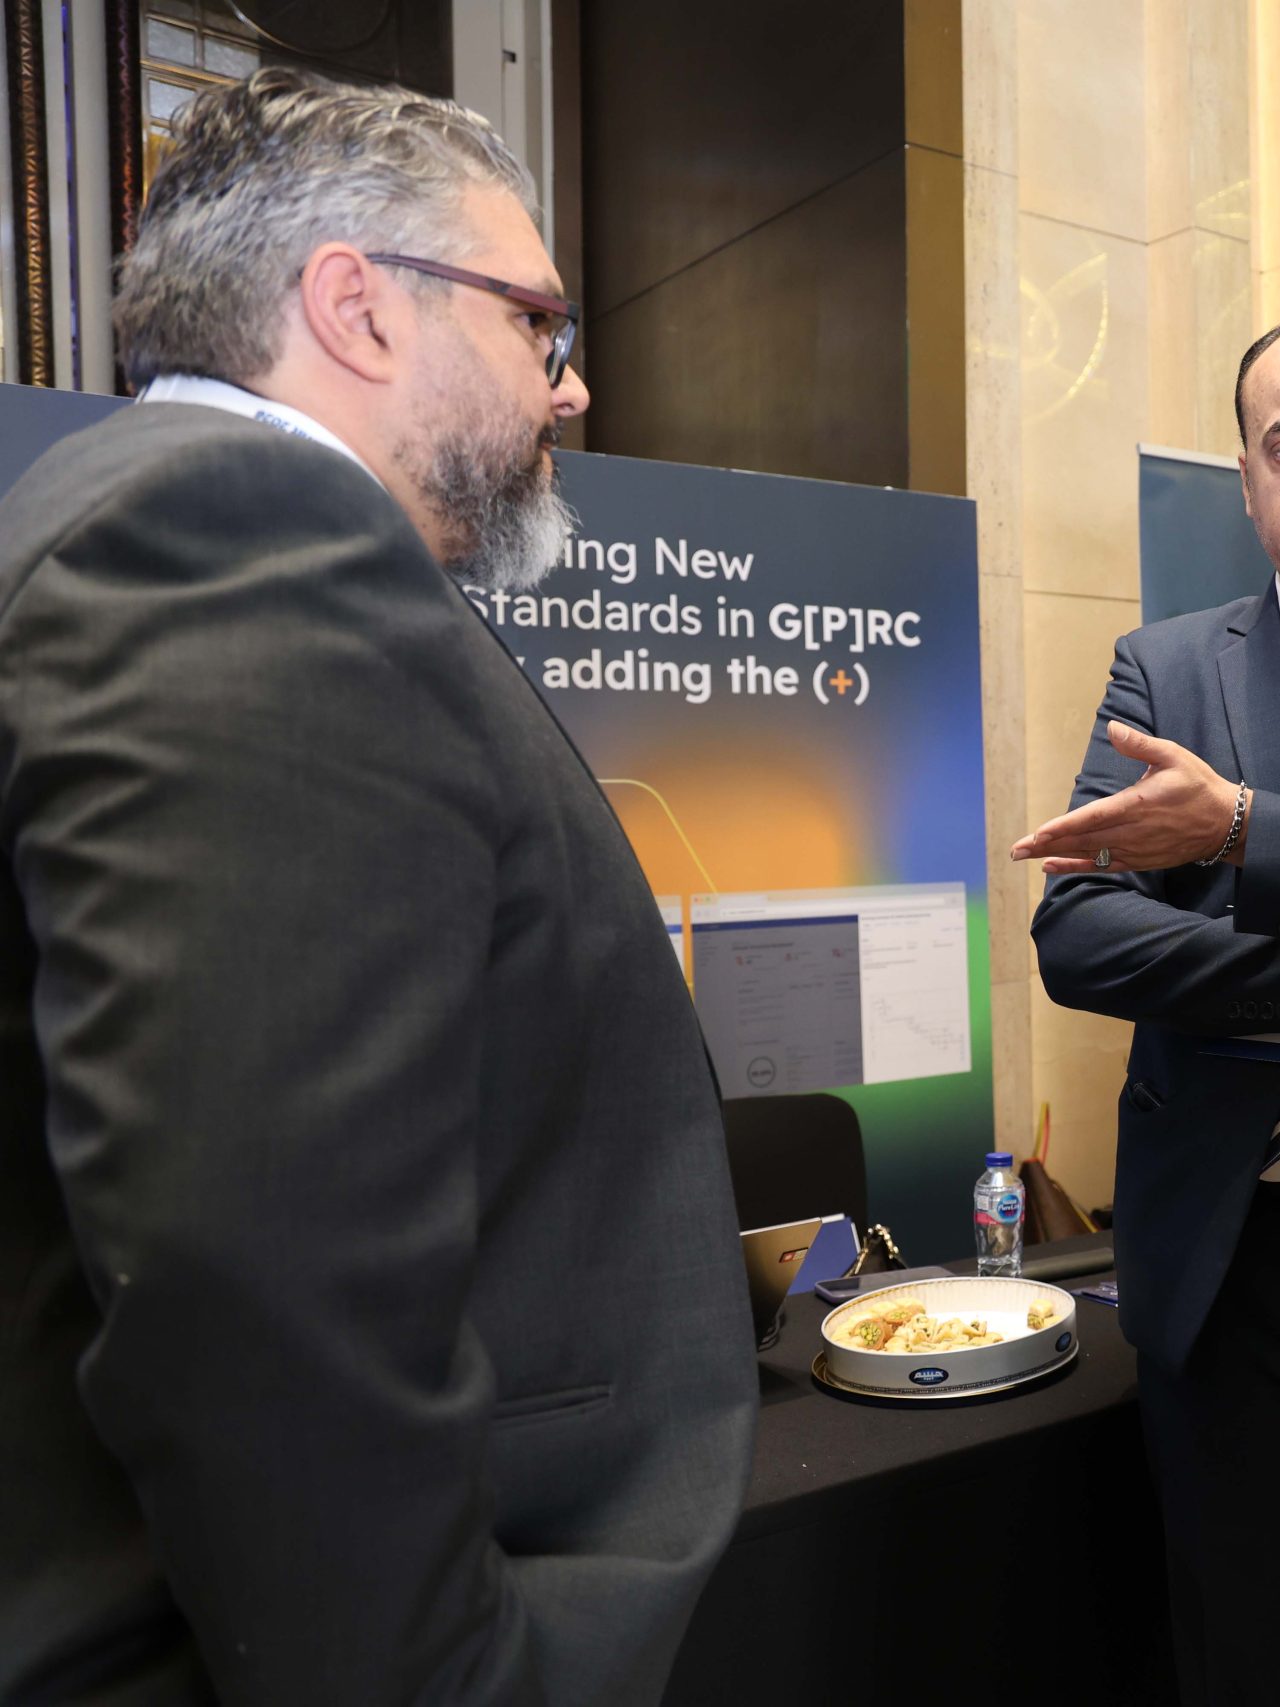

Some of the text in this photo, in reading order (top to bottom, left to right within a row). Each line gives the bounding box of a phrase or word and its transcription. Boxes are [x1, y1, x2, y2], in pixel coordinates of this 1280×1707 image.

[655, 537, 754, 581] New
[462, 584, 921, 652] Standards in G[P]RC
[543, 648, 711, 703] adding
[727, 655, 799, 695] the
